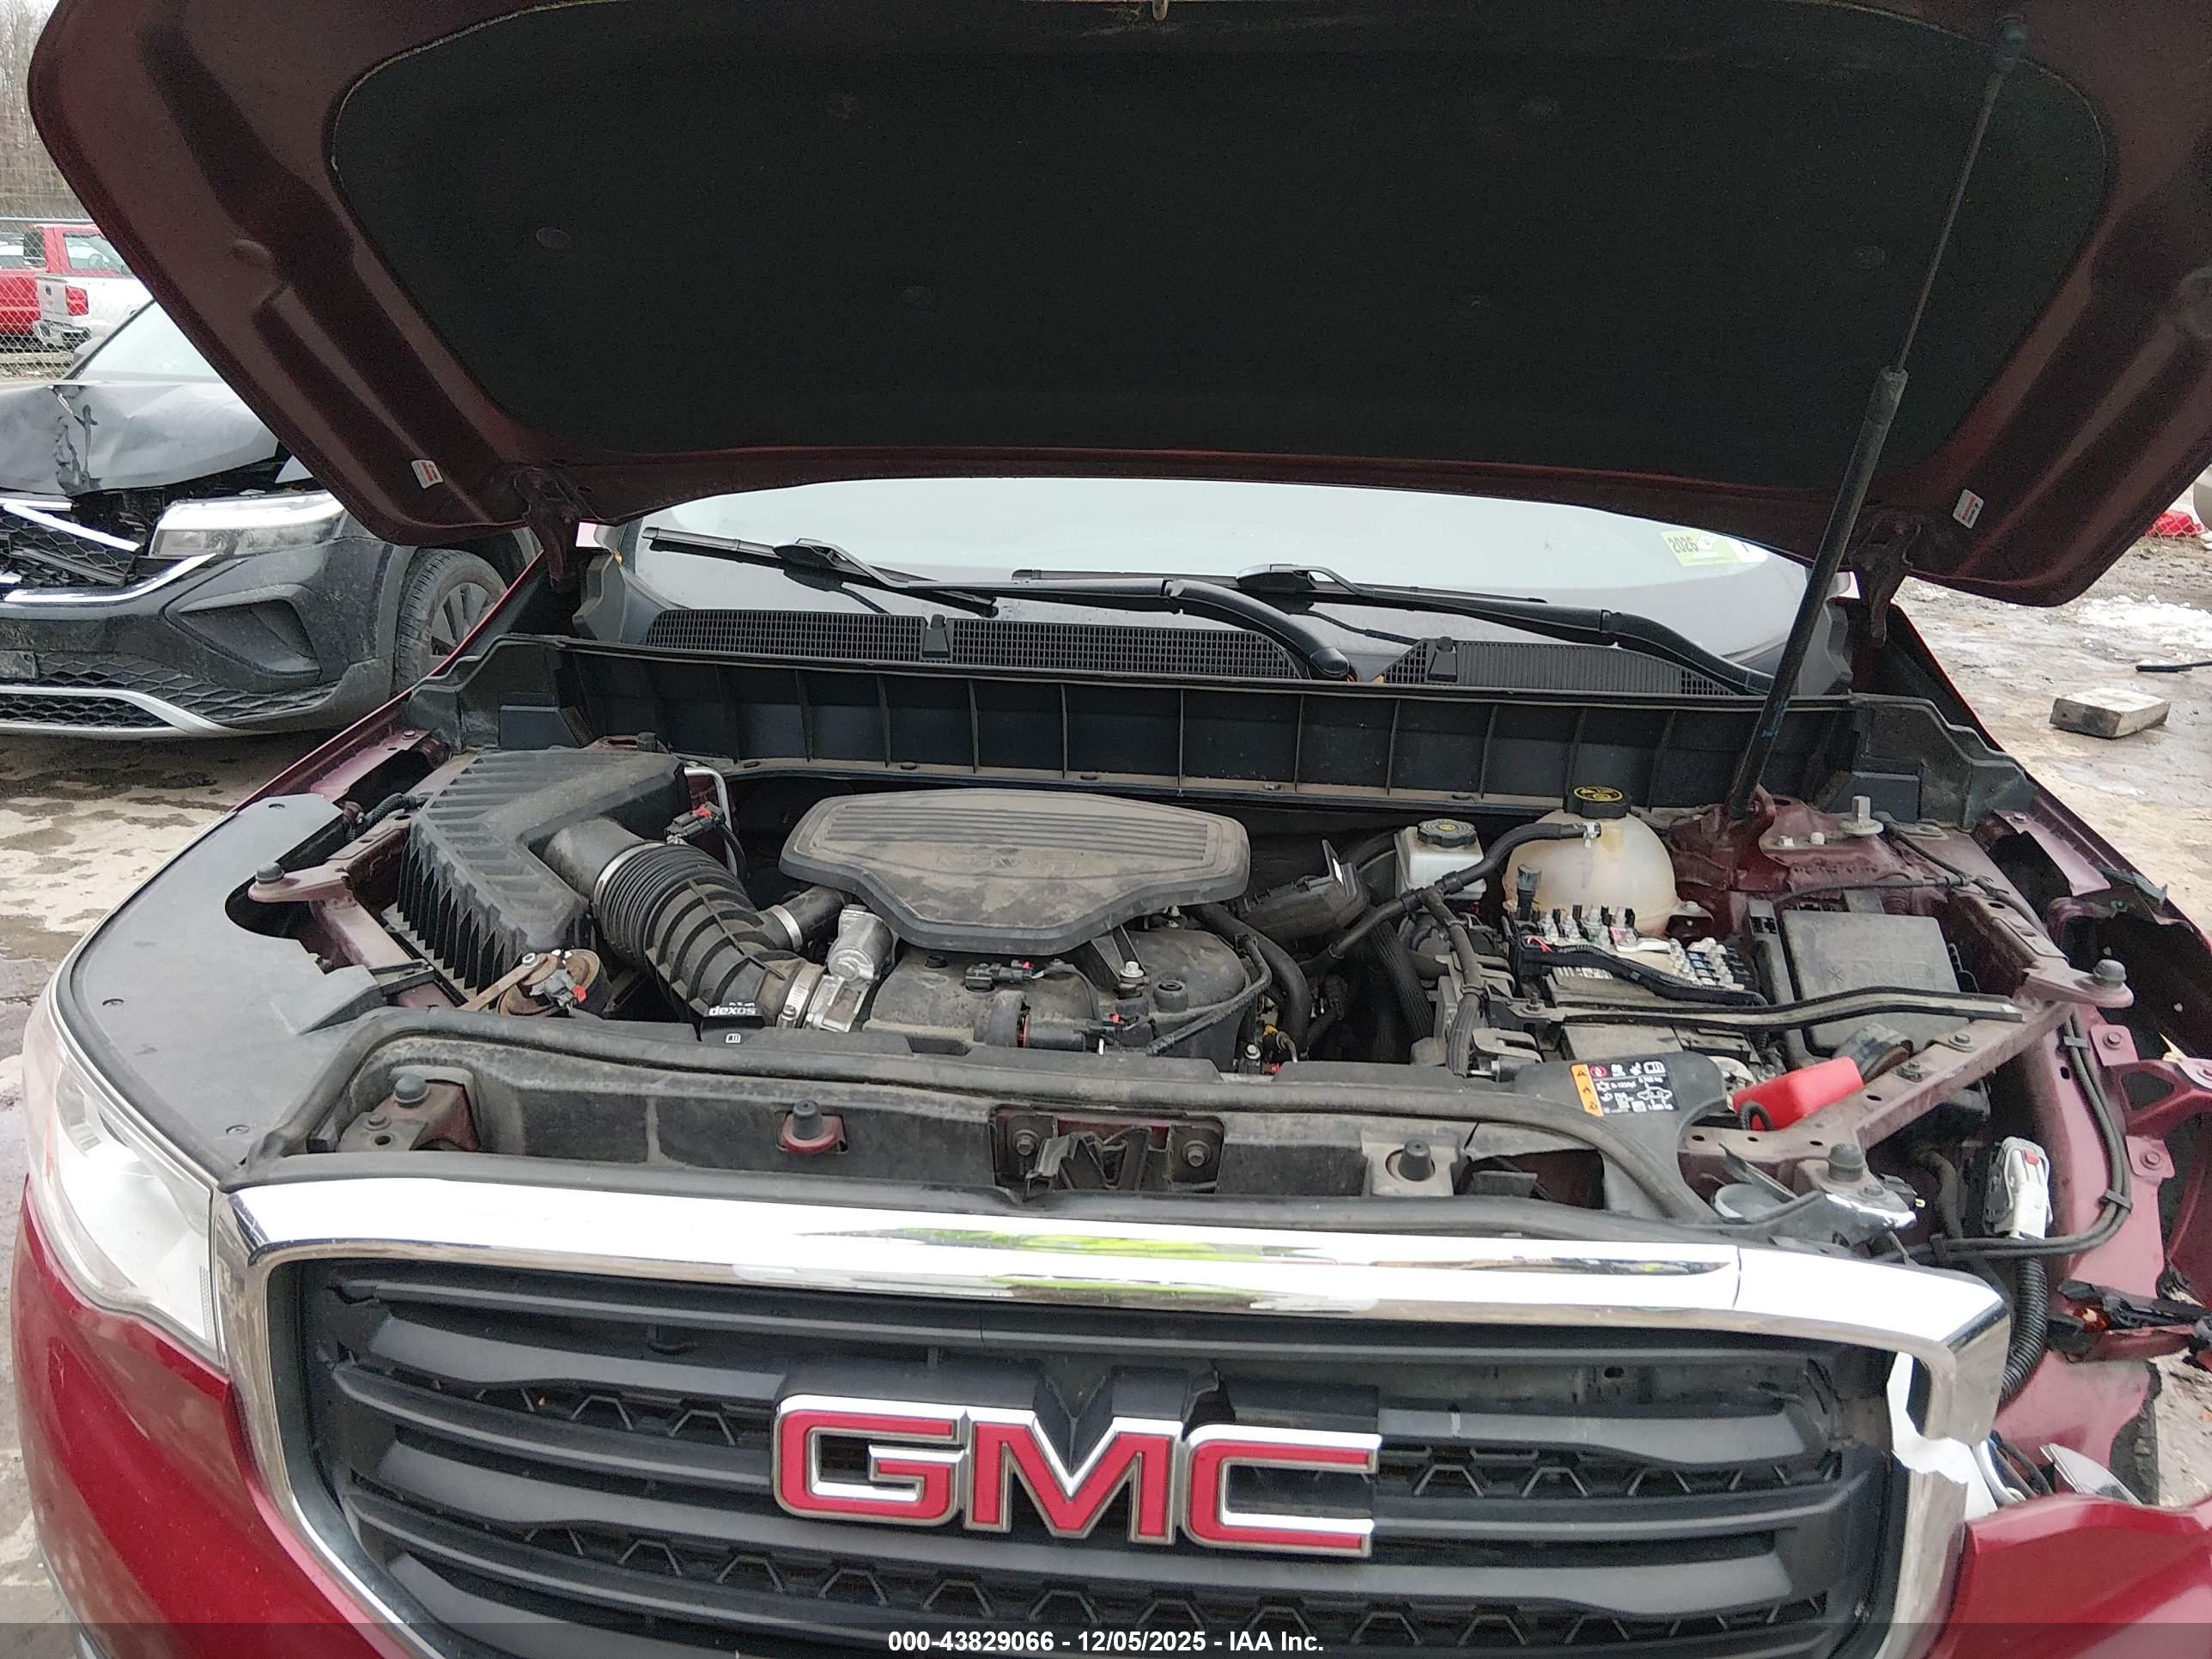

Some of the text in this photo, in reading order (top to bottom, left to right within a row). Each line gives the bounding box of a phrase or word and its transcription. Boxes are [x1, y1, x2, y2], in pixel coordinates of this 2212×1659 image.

[1668, 536, 1699, 554] 2026
[708, 1006, 757, 1016] dexos
[774, 1395, 1382, 1558] GMC
